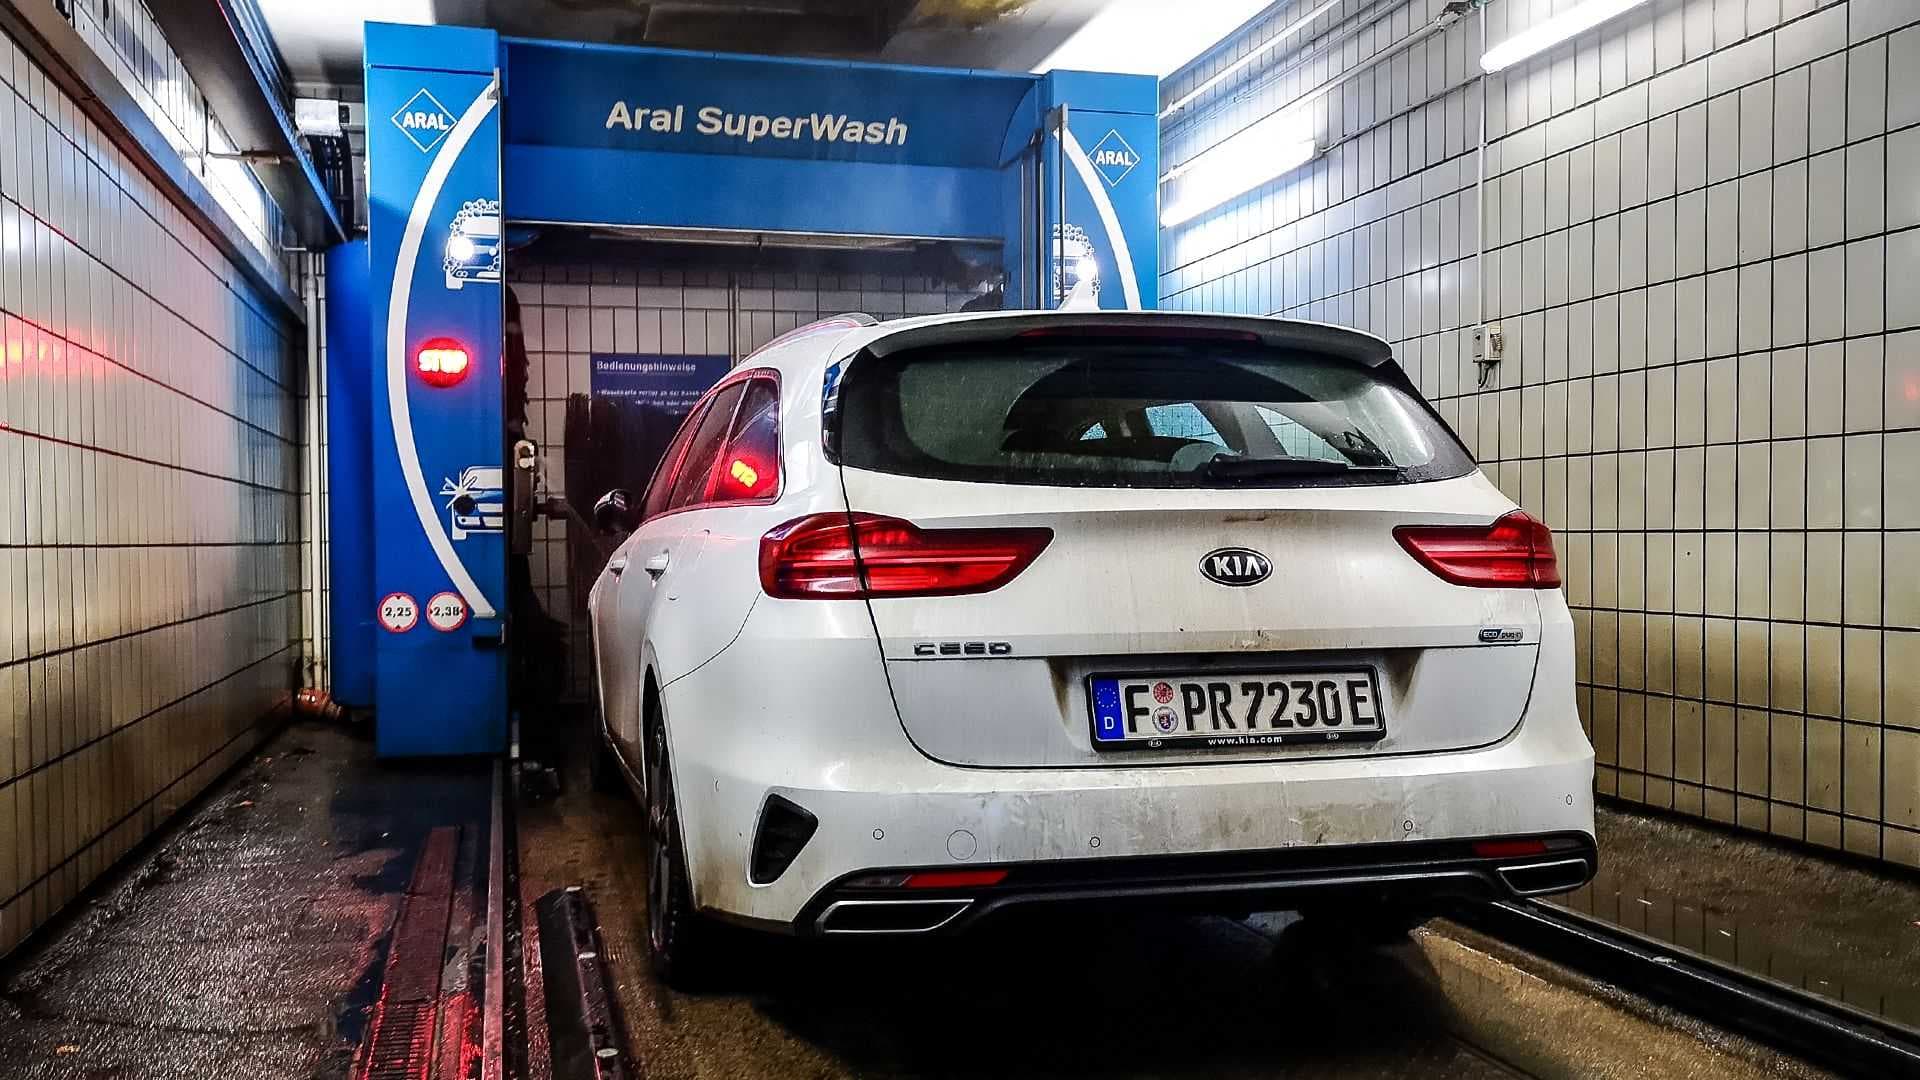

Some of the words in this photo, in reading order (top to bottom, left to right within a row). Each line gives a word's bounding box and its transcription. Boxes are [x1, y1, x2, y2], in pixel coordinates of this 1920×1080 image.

[402, 111, 449, 131] ARAL
[605, 100, 684, 133] Aral
[695, 106, 909, 146] SuperWash
[1095, 149, 1133, 166] ARAL
[1212, 556, 1262, 576] KIA
[385, 607, 412, 617] 2,25
[433, 606, 460, 617] 2,38
[914, 642, 1012, 655] CEED
[1124, 685, 1150, 733] F
[1103, 716, 1115, 730] D
[1207, 736, 1283, 746] www.kia.com
